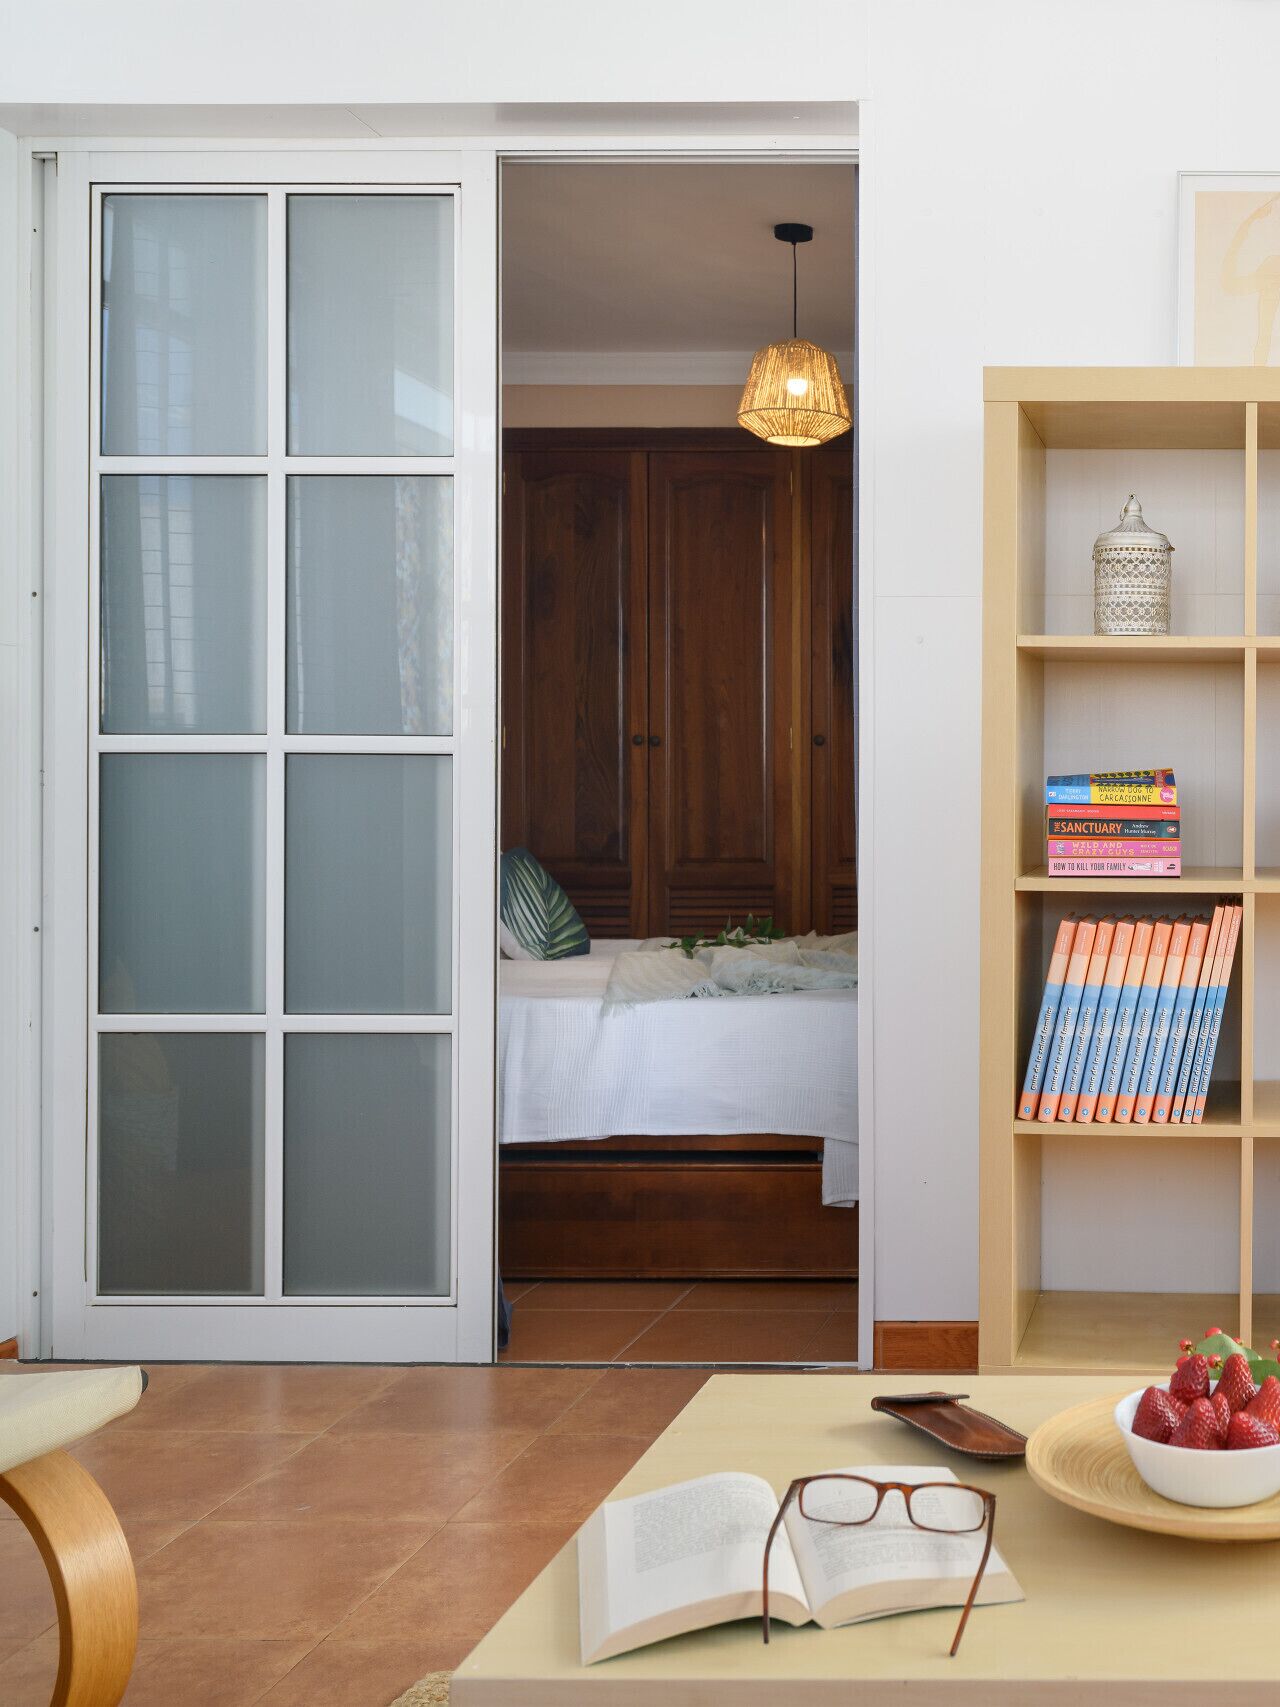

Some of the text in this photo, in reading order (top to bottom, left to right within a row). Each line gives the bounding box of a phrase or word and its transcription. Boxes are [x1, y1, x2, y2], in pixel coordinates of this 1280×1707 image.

[1099, 794, 1152, 802] CARCASSONNE
[1060, 822, 1122, 834] SANCTUARY
[1054, 862, 1126, 871] HOW TO KILL YOUR FAMILY
